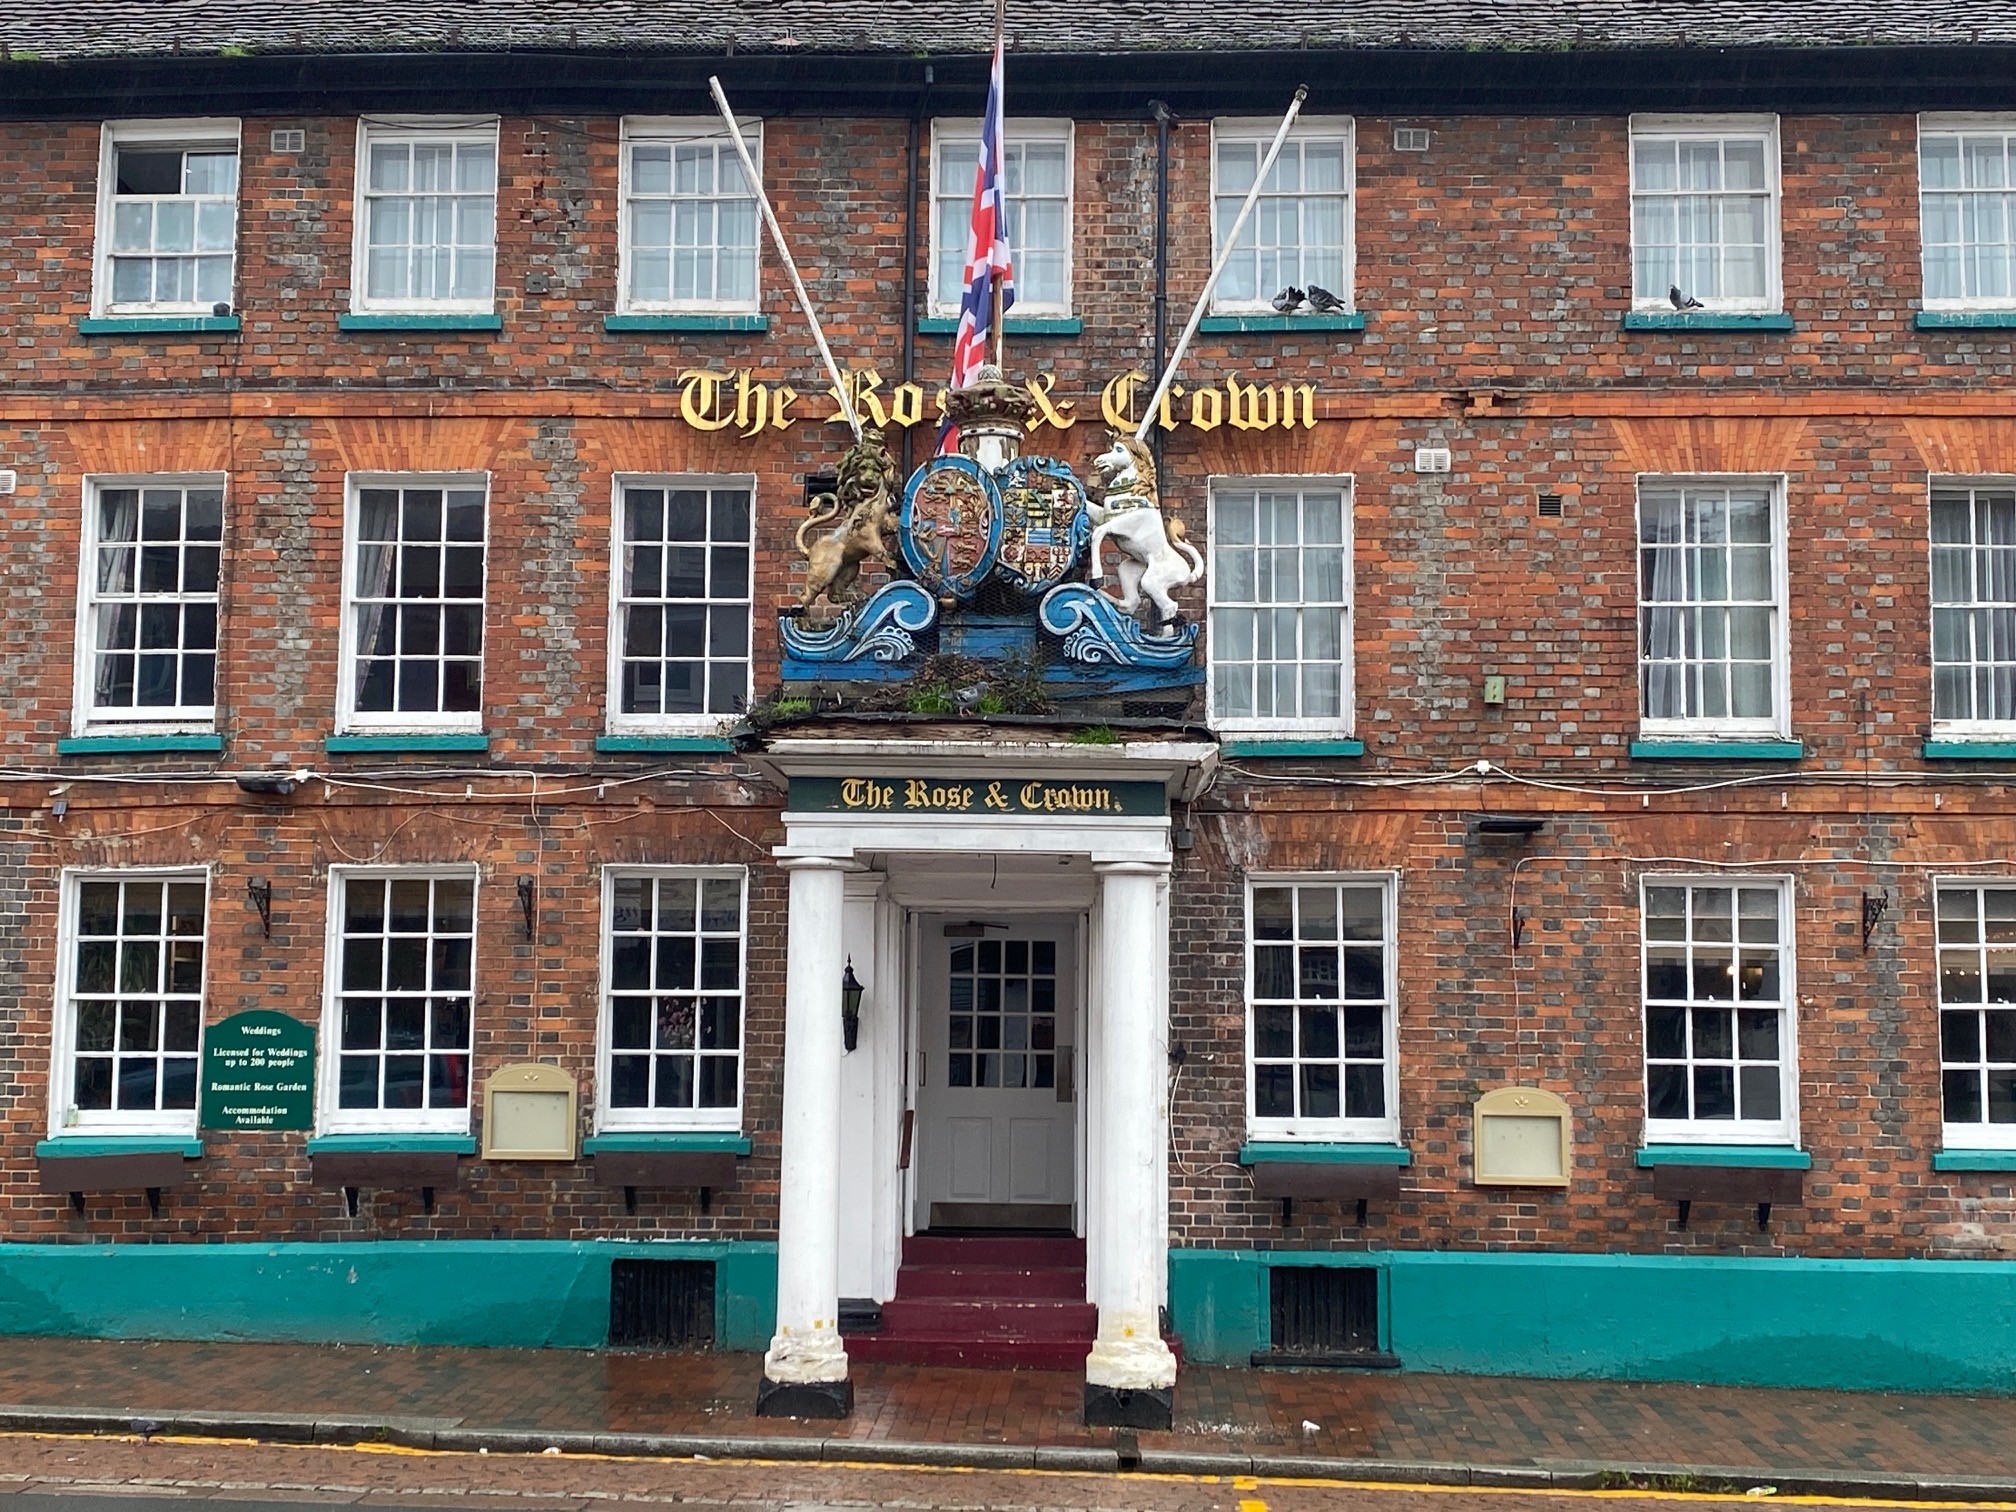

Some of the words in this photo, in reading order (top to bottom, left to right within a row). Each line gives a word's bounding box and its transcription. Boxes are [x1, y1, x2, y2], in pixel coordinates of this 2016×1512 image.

[678, 367, 798, 439] The
[1026, 372, 1076, 432] &
[1101, 367, 1319, 431] Crown
[841, 778, 893, 809] The
[903, 779, 974, 808] Rose
[984, 781, 1008, 807] &
[1020, 781, 1110, 811] Crown
[241, 1026, 281, 1036] Weddings
[213, 1047, 249, 1057] Licensed
[252, 1047, 264, 1057] for
[268, 1047, 308, 1058] Weddings
[225, 1060, 236, 1068] up
[239, 1058, 248, 1067] to
[250, 1058, 266, 1067] 200
[268, 1058, 295, 1069] people
[211, 1082, 251, 1092] Romantic
[254, 1082, 274, 1092] Rose
[276, 1082, 307, 1092] Garden
[222, 1105, 288, 1115] Accommodation
[235, 1115, 274, 1125] Available
